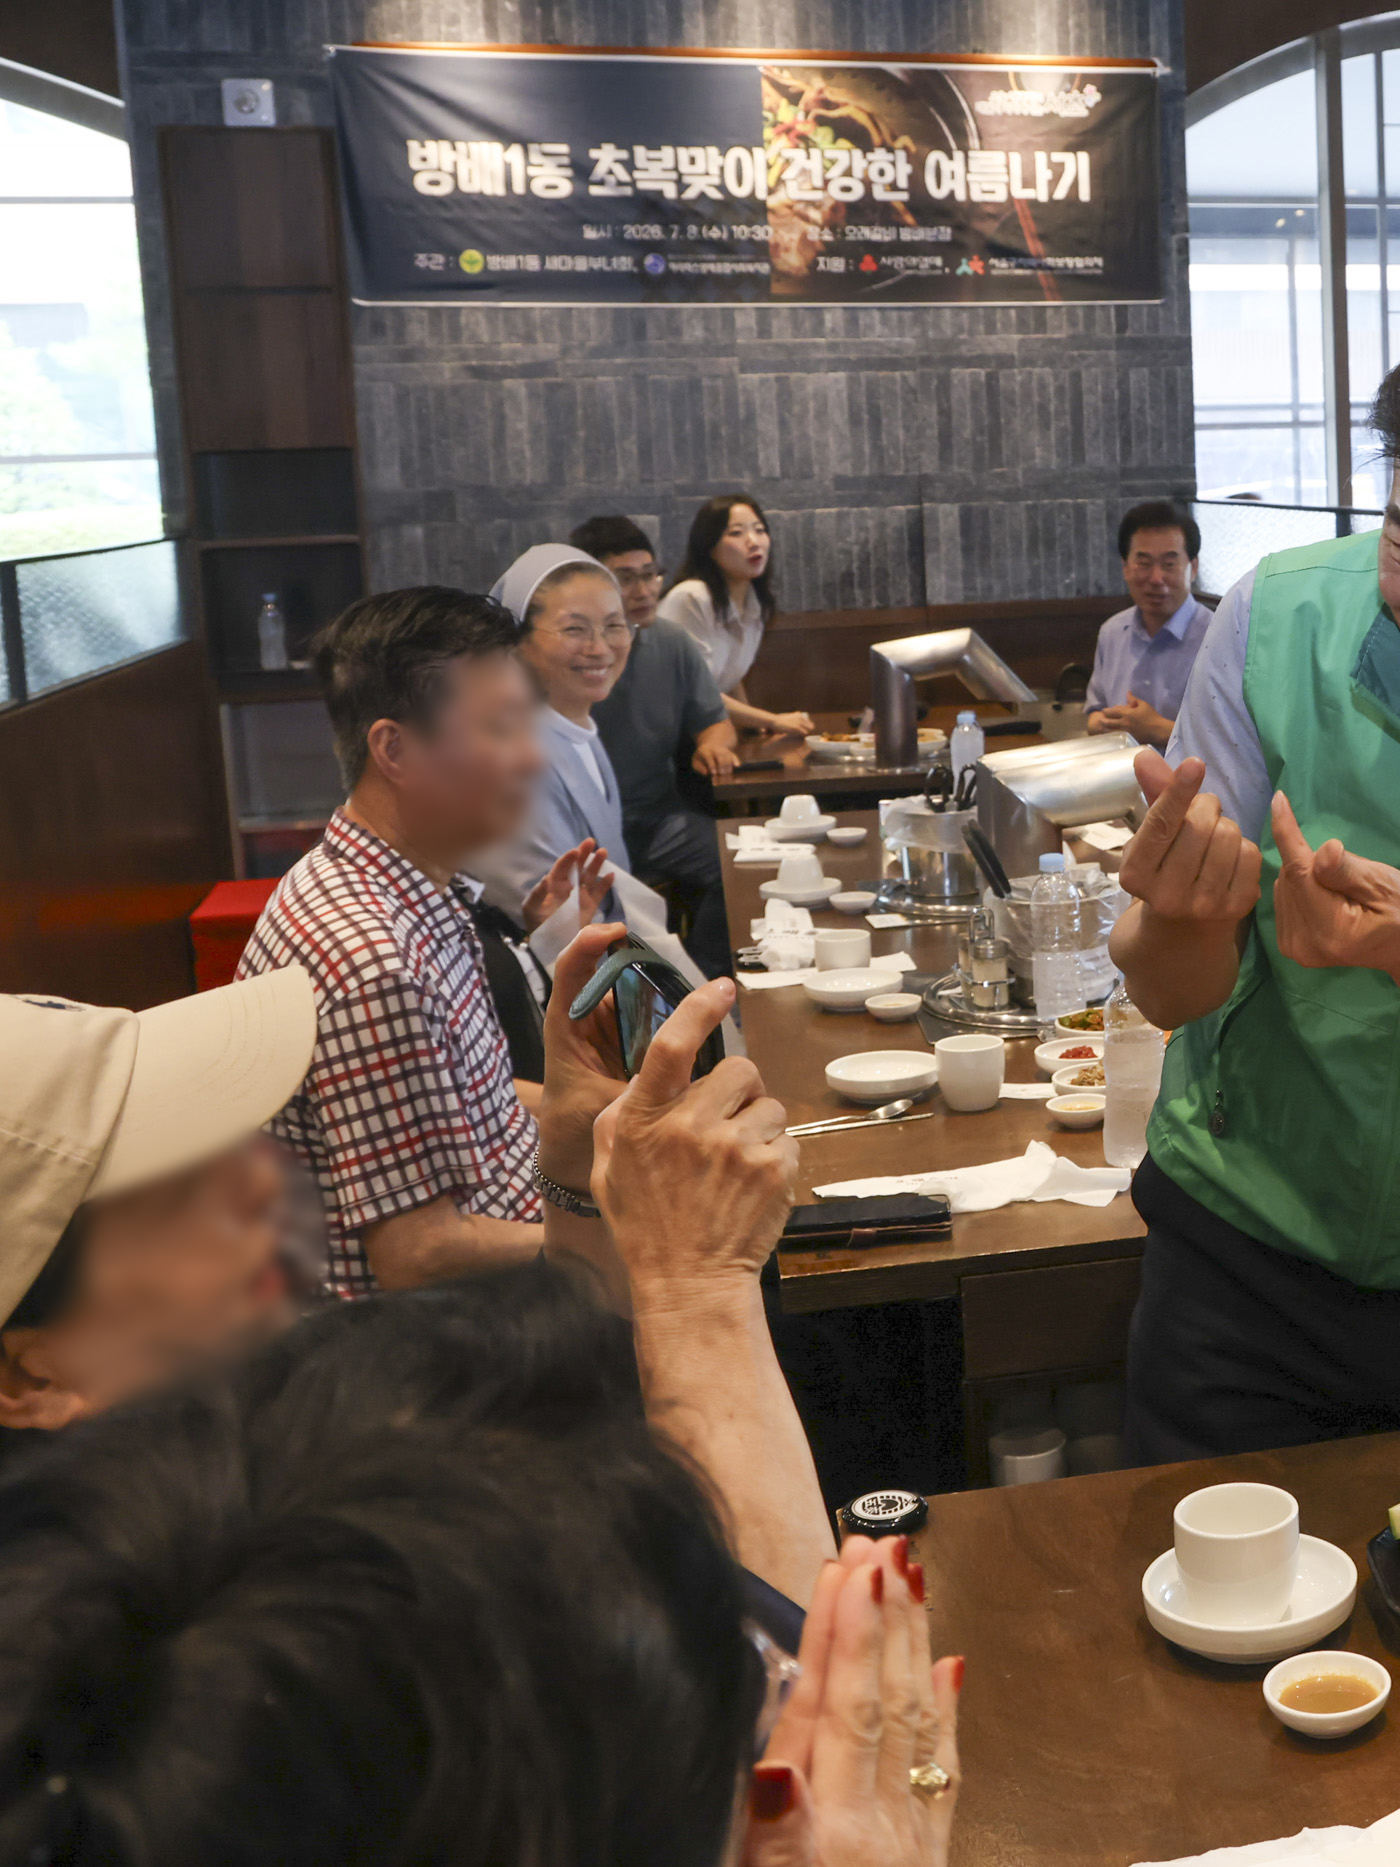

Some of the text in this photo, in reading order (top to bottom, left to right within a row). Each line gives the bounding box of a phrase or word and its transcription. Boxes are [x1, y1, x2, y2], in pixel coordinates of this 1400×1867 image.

[406, 139, 1091, 203] 방배1동 초복맞이 건강한 여름나기
[582, 224, 613, 240] 일시
[731, 224, 774, 241] 10:30
[806, 226, 834, 242] 장소
[414, 253, 446, 271] 주관
[486, 254, 542, 272] 방배1동
[816, 256, 846, 273] 지원
